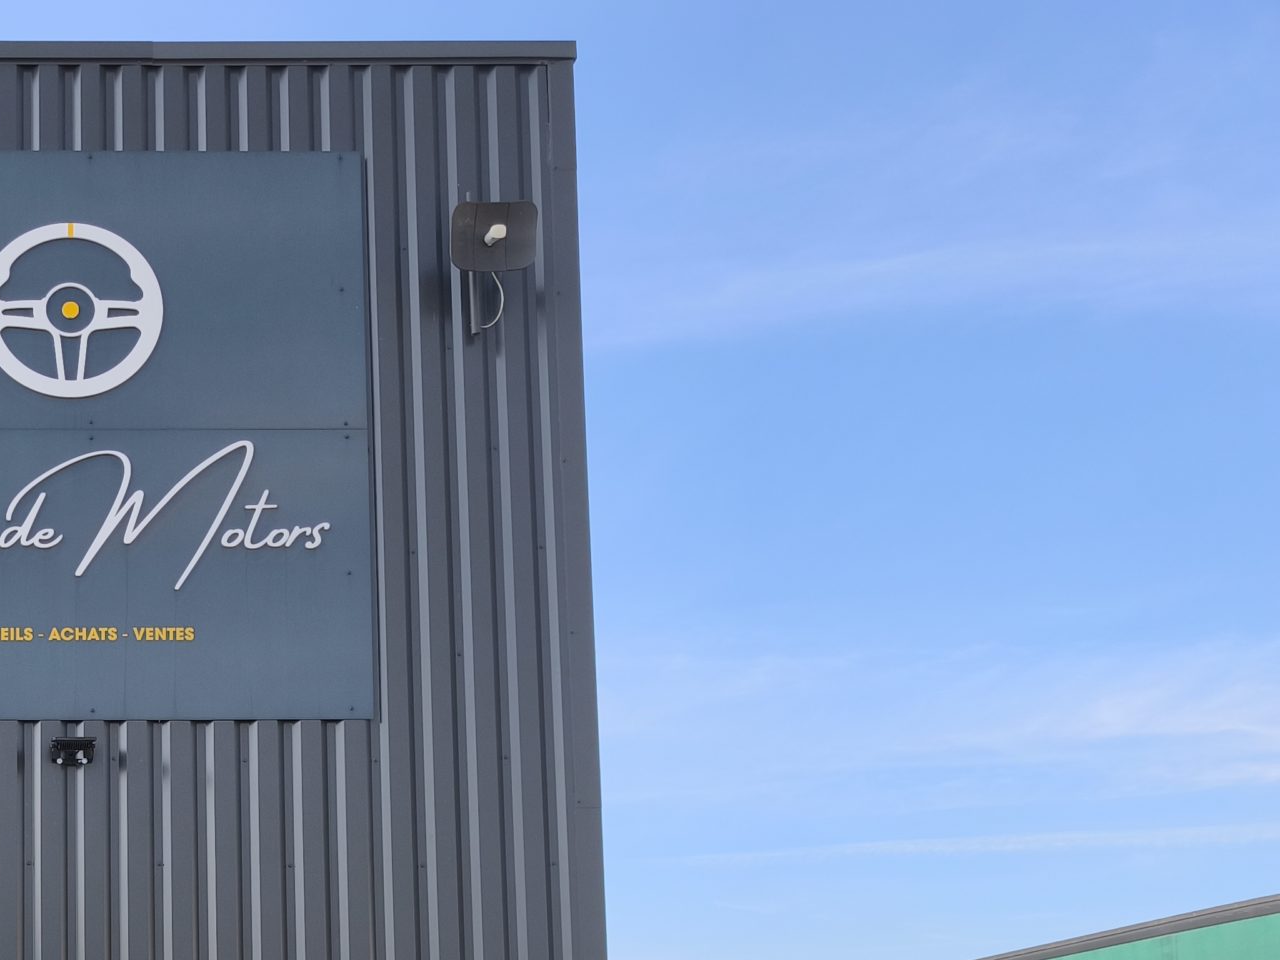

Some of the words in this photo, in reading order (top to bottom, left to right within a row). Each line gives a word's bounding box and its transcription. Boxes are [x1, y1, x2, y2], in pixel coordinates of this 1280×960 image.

[6, 440, 331, 591] Motors
[48, 626, 118, 642] ACHATS
[133, 626, 196, 642] VENTES
